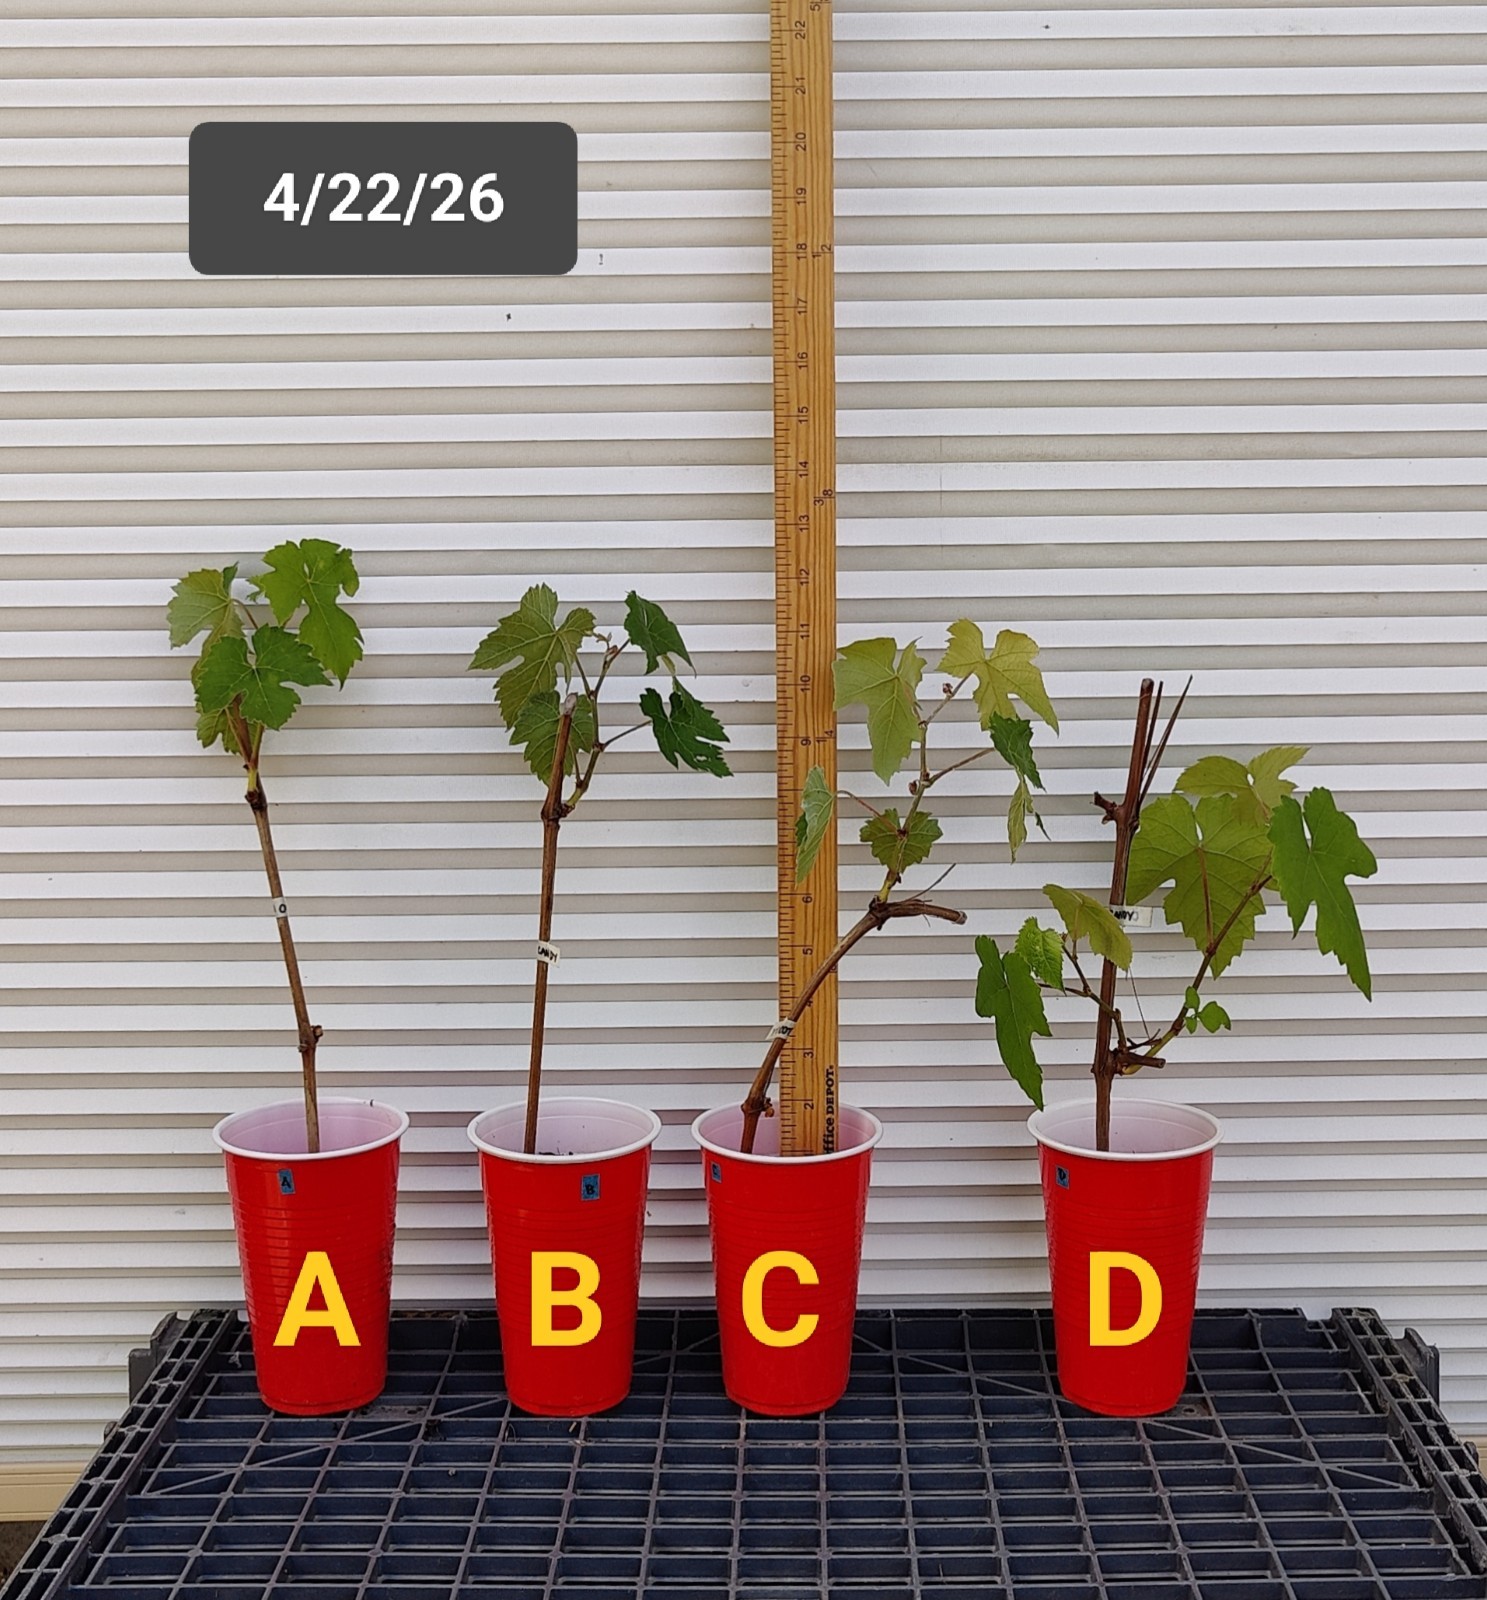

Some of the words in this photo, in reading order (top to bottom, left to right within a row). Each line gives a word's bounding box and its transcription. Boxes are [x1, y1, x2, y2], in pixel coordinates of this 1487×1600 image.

[795, 20, 806, 40] 22
[795, 76, 806, 95] 21
[795, 132, 807, 152] 20
[796, 187, 807, 205] 19
[796, 242, 807, 260] 18
[797, 297, 808, 315] 17
[797, 351, 808, 370] 16
[798, 406, 809, 424] 15
[798, 461, 809, 478] 14
[799, 514, 810, 532] 13
[800, 568, 810, 586] 12
[800, 623, 810, 639] 11
[800, 675, 811, 693] 10
[801, 738, 812, 747] 9
[802, 895, 813, 904] 6
[802, 948, 813, 956] 5
[803, 1051, 814, 1059] 3
[823, 1117, 835, 1154] ffice
[281, 1175, 292, 1189] A
